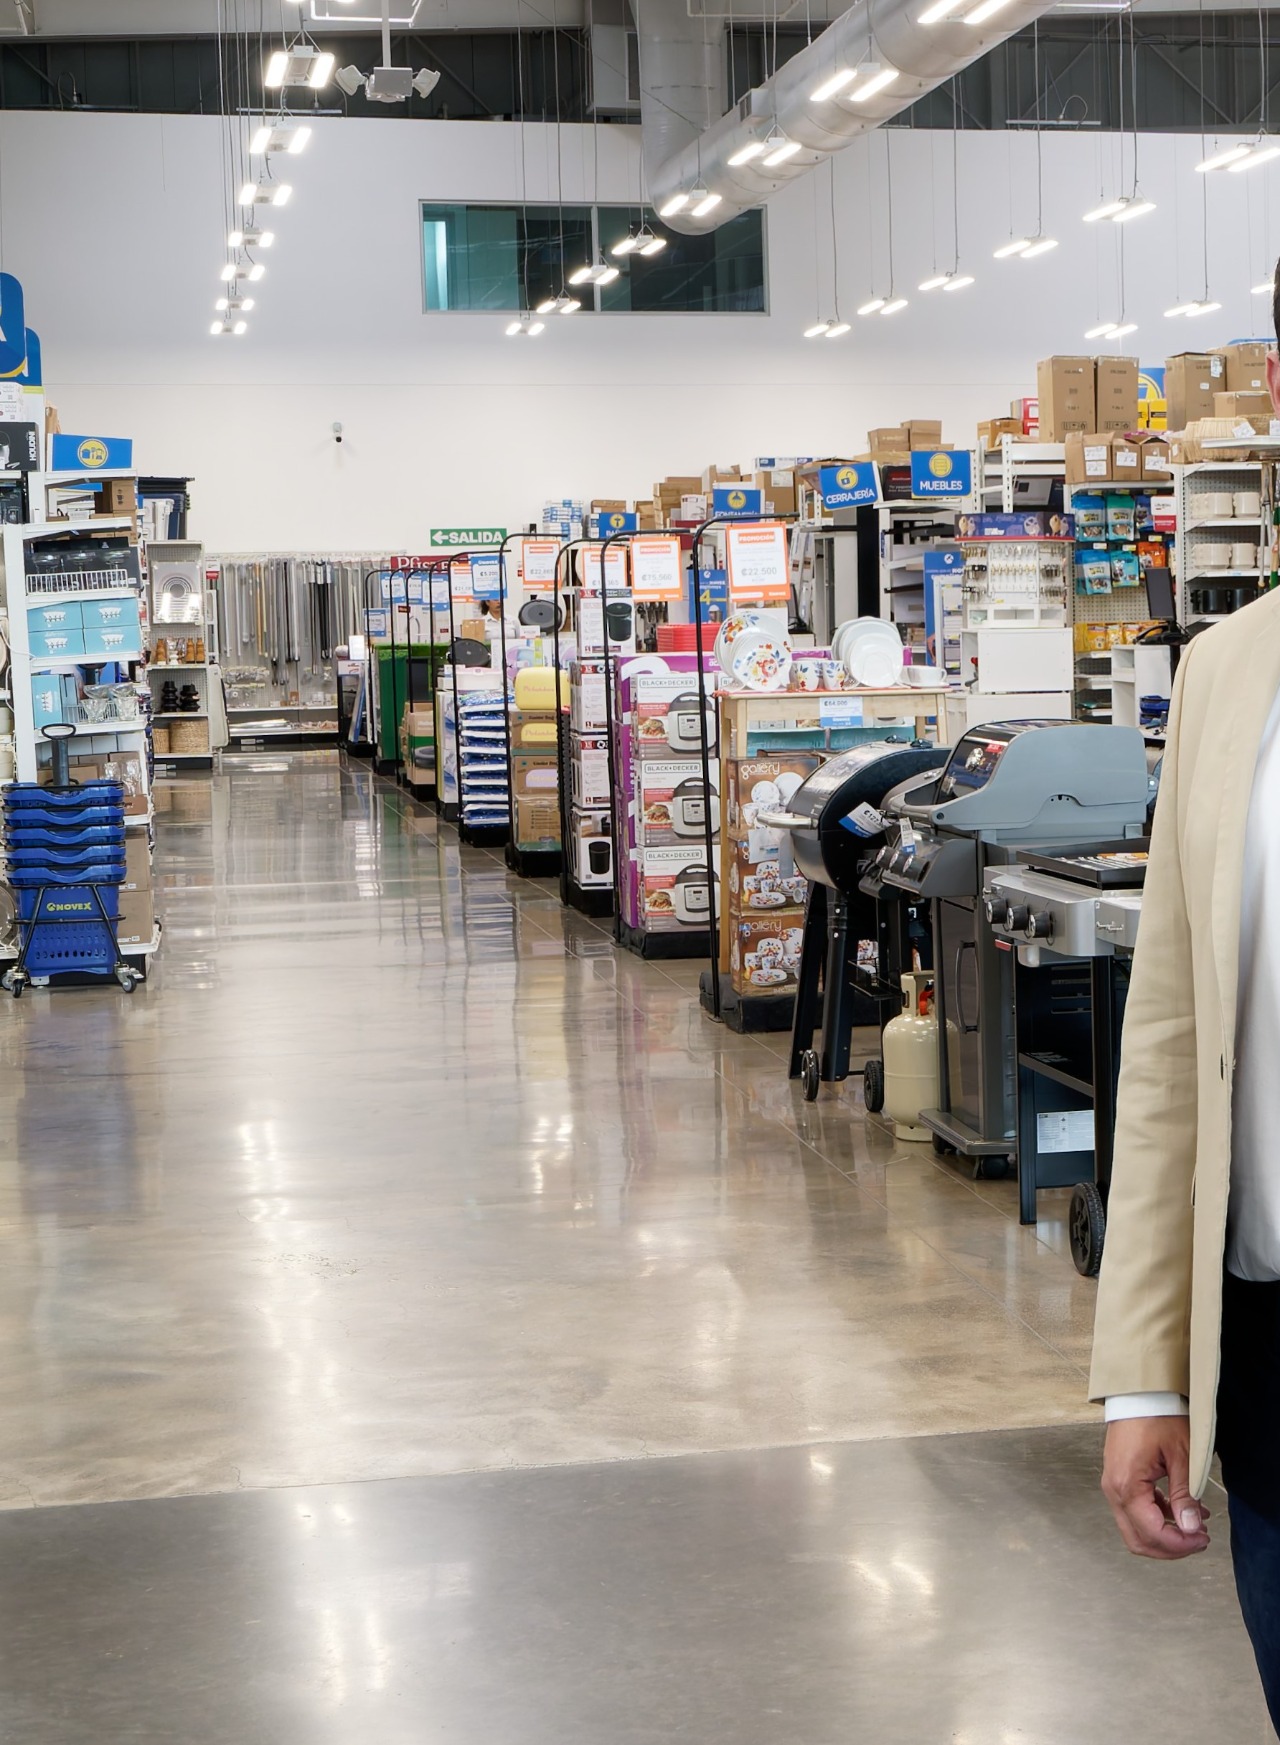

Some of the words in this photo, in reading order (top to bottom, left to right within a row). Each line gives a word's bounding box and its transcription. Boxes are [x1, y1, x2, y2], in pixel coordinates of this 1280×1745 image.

[919, 480, 963, 491] MUEBLES
[826, 487, 875, 505] CERRAJERÍA
[449, 531, 504, 544] SALIDA
[740, 761, 780, 780] gallery
[648, 851, 700, 859] BLACK+DECKER
[56, 902, 92, 911] NOVEX
